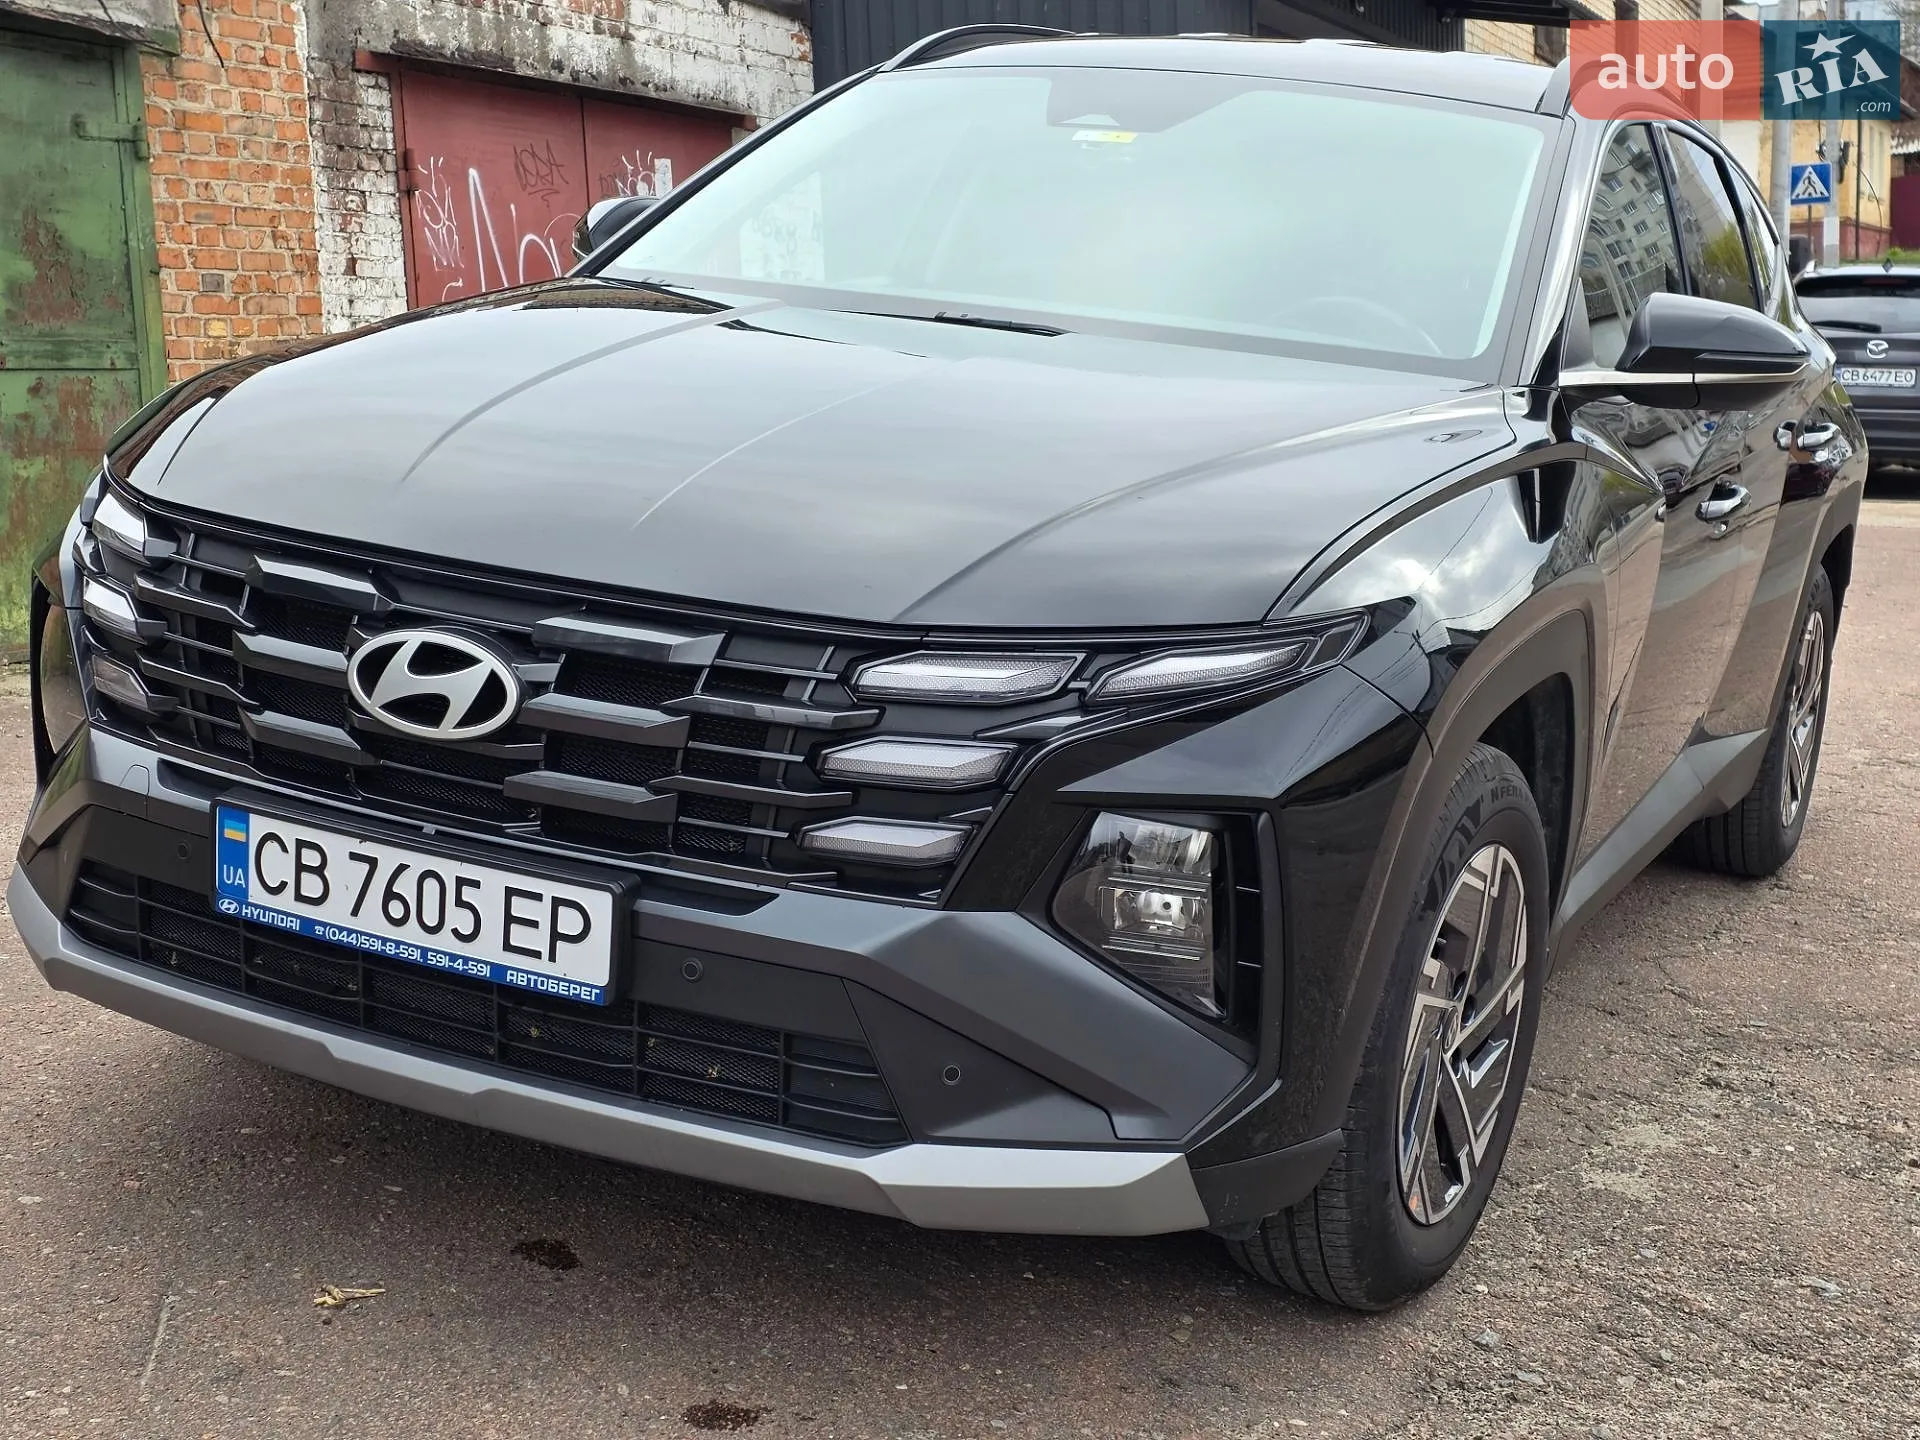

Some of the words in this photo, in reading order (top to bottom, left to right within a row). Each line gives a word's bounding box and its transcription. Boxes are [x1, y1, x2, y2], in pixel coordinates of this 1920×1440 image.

[1841, 369, 1860, 382] CB
[1862, 369, 1892, 383] 6477
[223, 865, 246, 888] UA
[254, 831, 330, 907] CB
[346, 850, 482, 944] 7605
[502, 886, 592, 963] EP
[242, 904, 300, 931] HYUNDAI
[427, 952, 491, 978] 591-4-591
[506, 970, 600, 1001] АВТОБЕРЕГ
